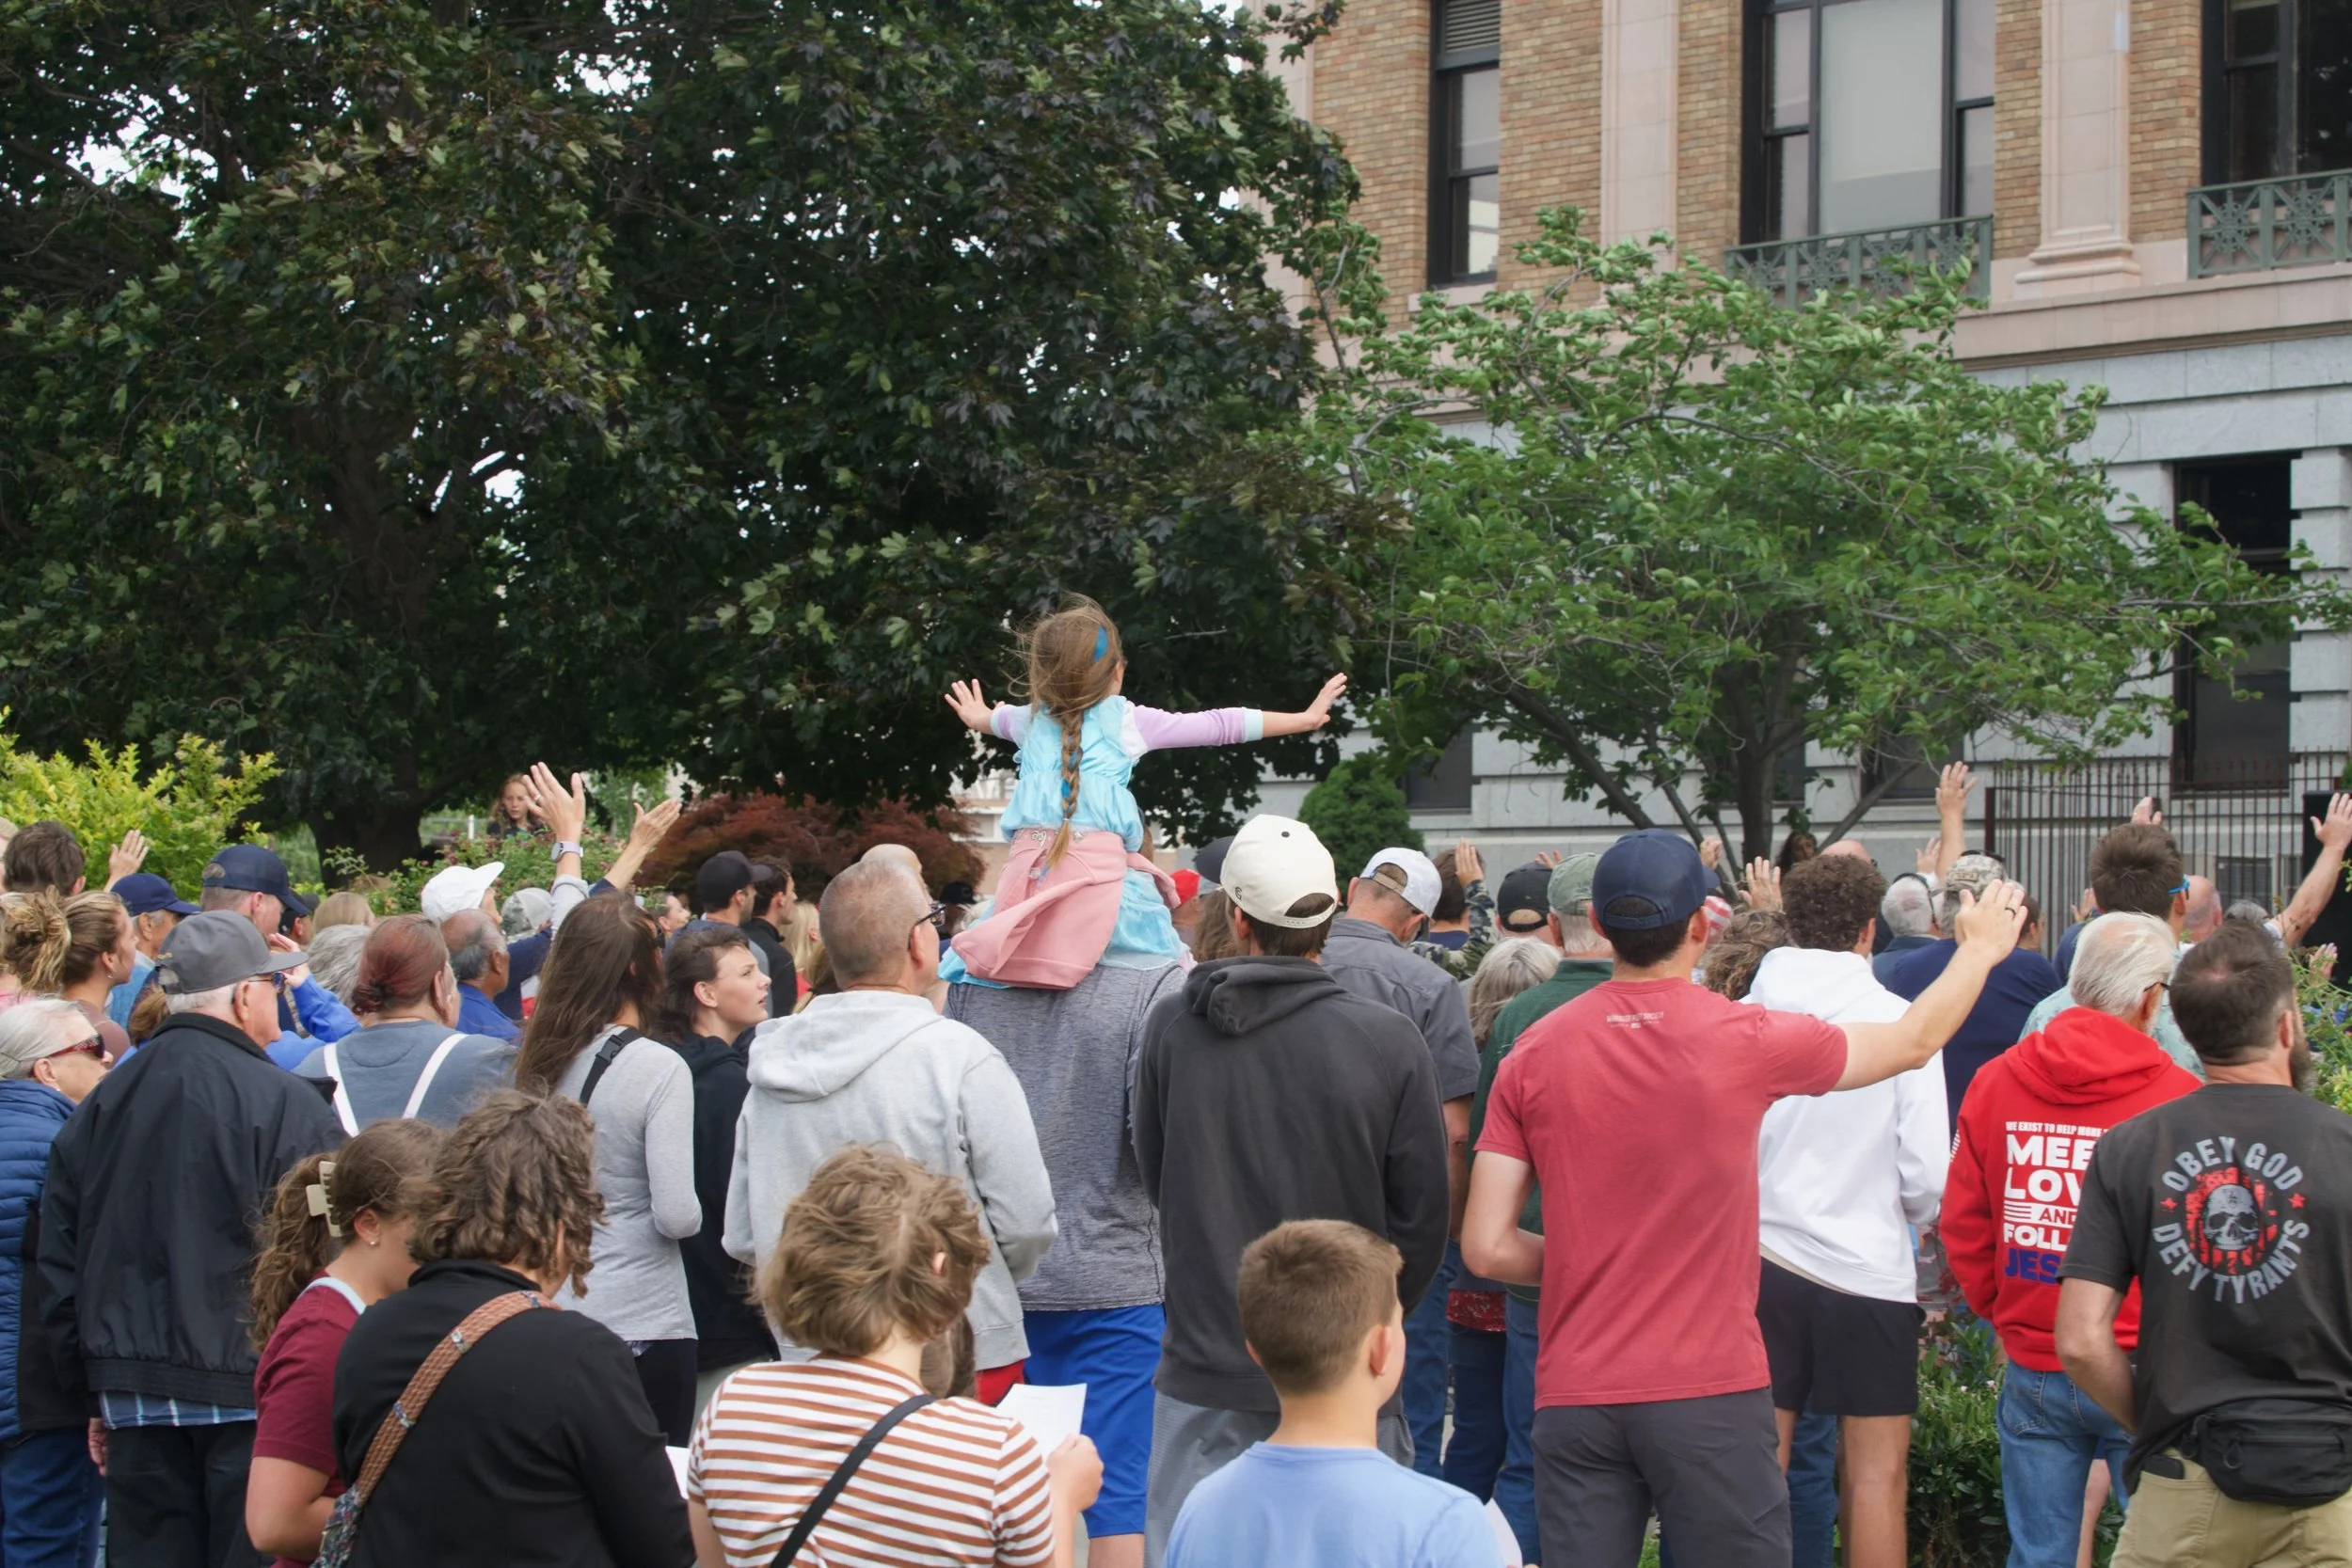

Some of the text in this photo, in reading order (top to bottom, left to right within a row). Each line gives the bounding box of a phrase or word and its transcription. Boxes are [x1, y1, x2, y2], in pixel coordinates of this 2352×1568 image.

[2006, 1121, 2017, 1132] WE
[2018, 1122, 2042, 1132] EXIST
[2044, 1123, 2056, 1133] TO
[2056, 1124, 2076, 1135] HELP
[2007, 1133, 2096, 1170] MEE
[2162, 1136, 2303, 1192] OBEY GOD
[2004, 1166, 2081, 1206] LOV
[2003, 1222, 2068, 1252] FOLL
[2004, 1247, 2061, 1284] JES
[2152, 1220, 2311, 1304] DEFY TYRANTS
